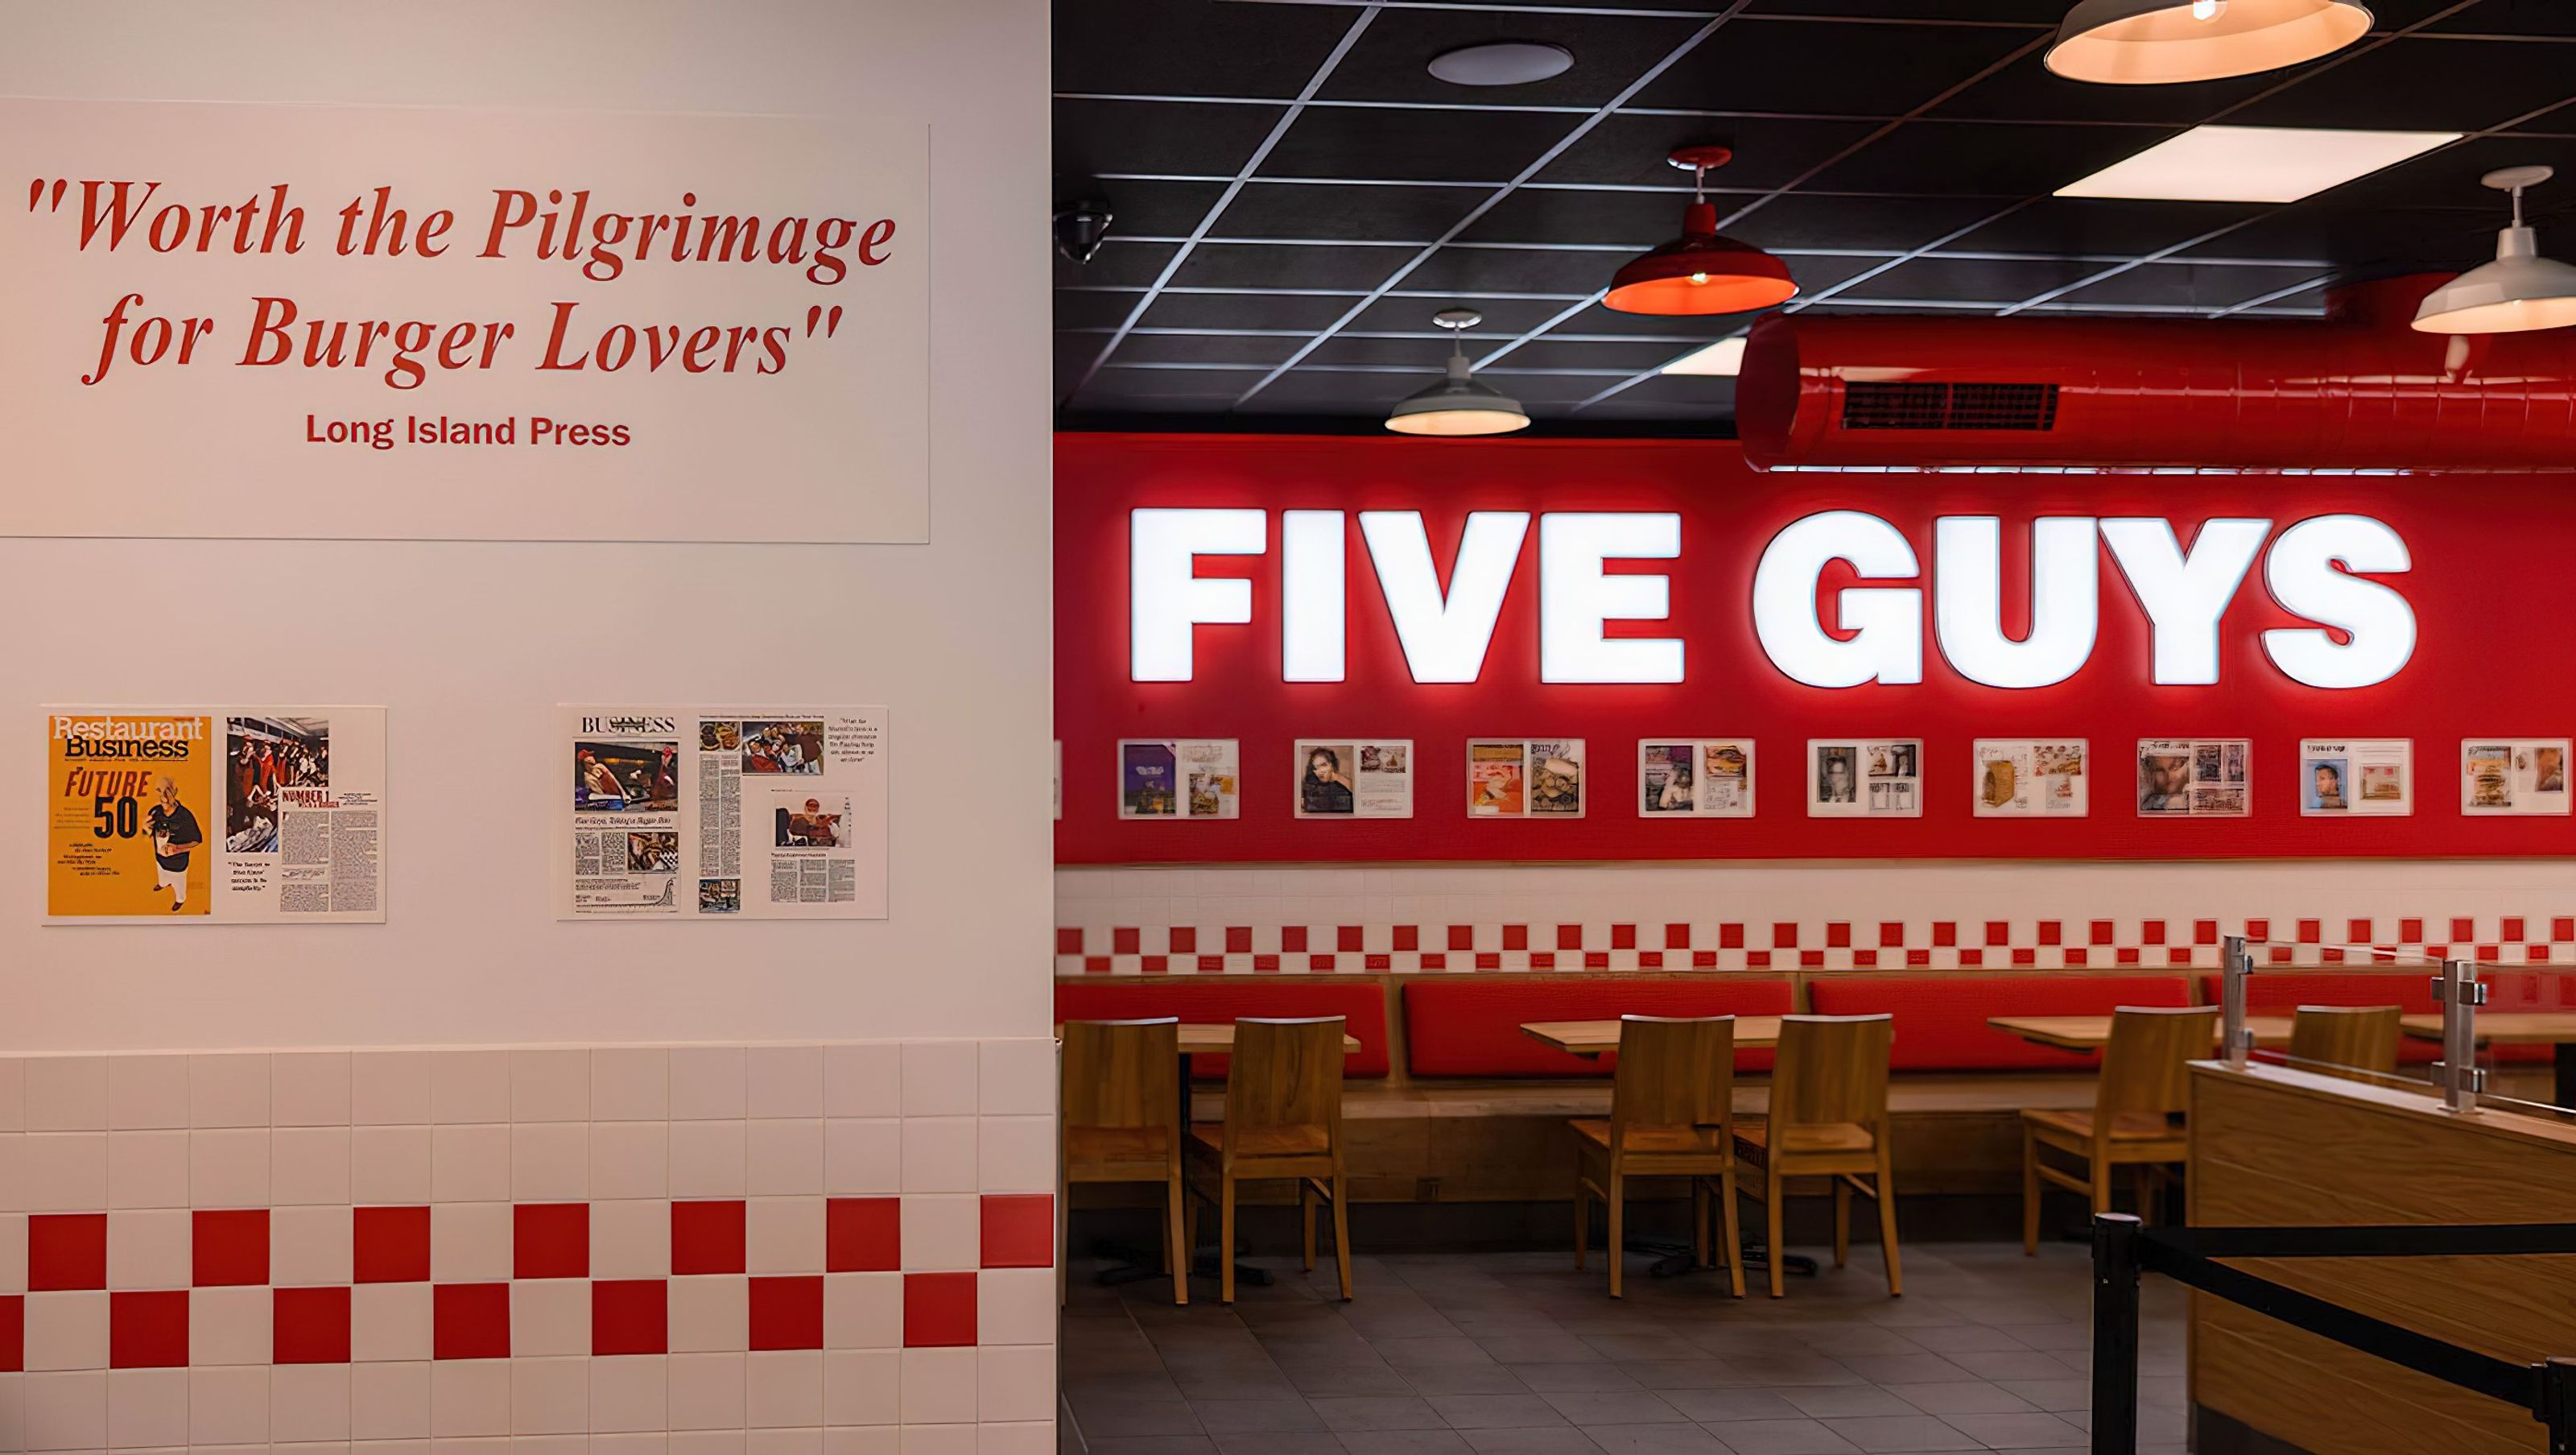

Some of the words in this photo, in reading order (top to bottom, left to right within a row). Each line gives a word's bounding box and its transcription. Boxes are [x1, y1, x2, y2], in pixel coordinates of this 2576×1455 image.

[30, 179, 304, 254] "Worth
[336, 186, 453, 258] the
[477, 189, 895, 283] Pilgrimage
[81, 294, 213, 385] for
[236, 297, 514, 389] Burger
[536, 302, 841, 374] Lovers"
[307, 414, 394, 450] Long
[407, 415, 516, 445] Island
[530, 417, 630, 446] Press
[1130, 508, 1686, 684] FIVE
[1752, 510, 2417, 689] GUYS
[53, 716, 203, 740] Restaurant
[582, 716, 675, 734] BUSINESS
[64, 734, 189, 758] Business
[64, 771, 152, 797] FUTURE
[93, 796, 138, 839] 50
